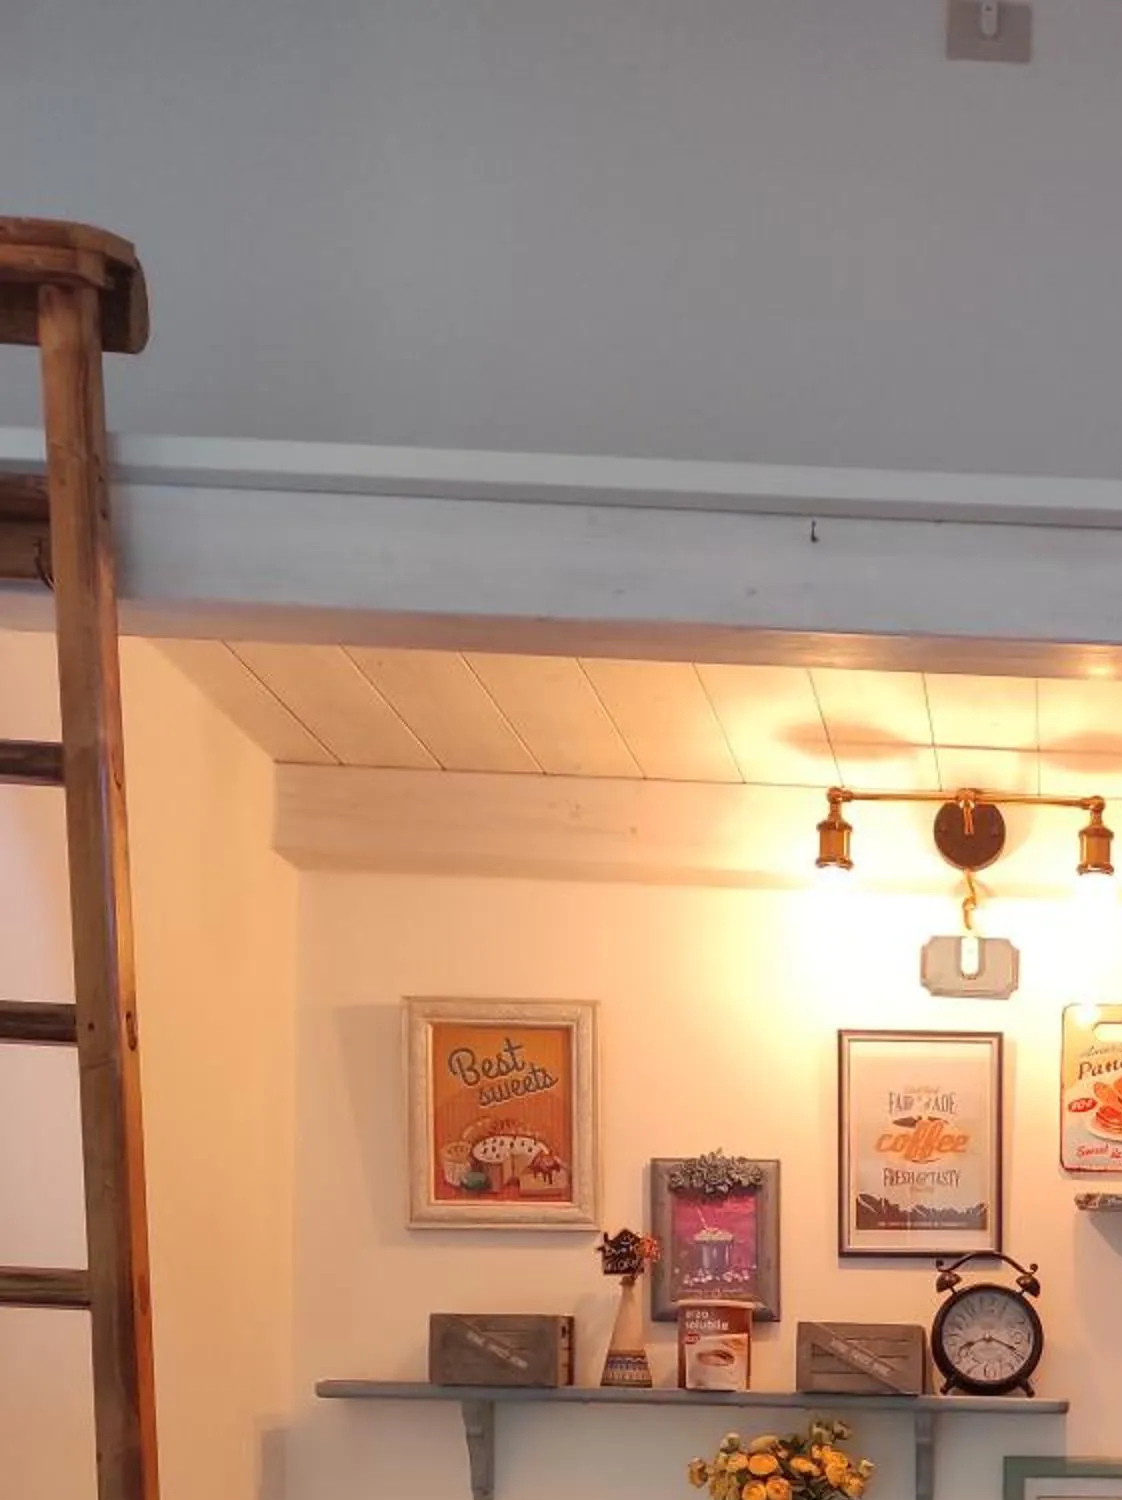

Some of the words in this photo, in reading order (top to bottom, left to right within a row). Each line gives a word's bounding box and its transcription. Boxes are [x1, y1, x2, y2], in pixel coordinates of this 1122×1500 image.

[447, 1037, 525, 1087] Best
[479, 1062, 559, 1107] sweets
[875, 1120, 970, 1161] coffee
